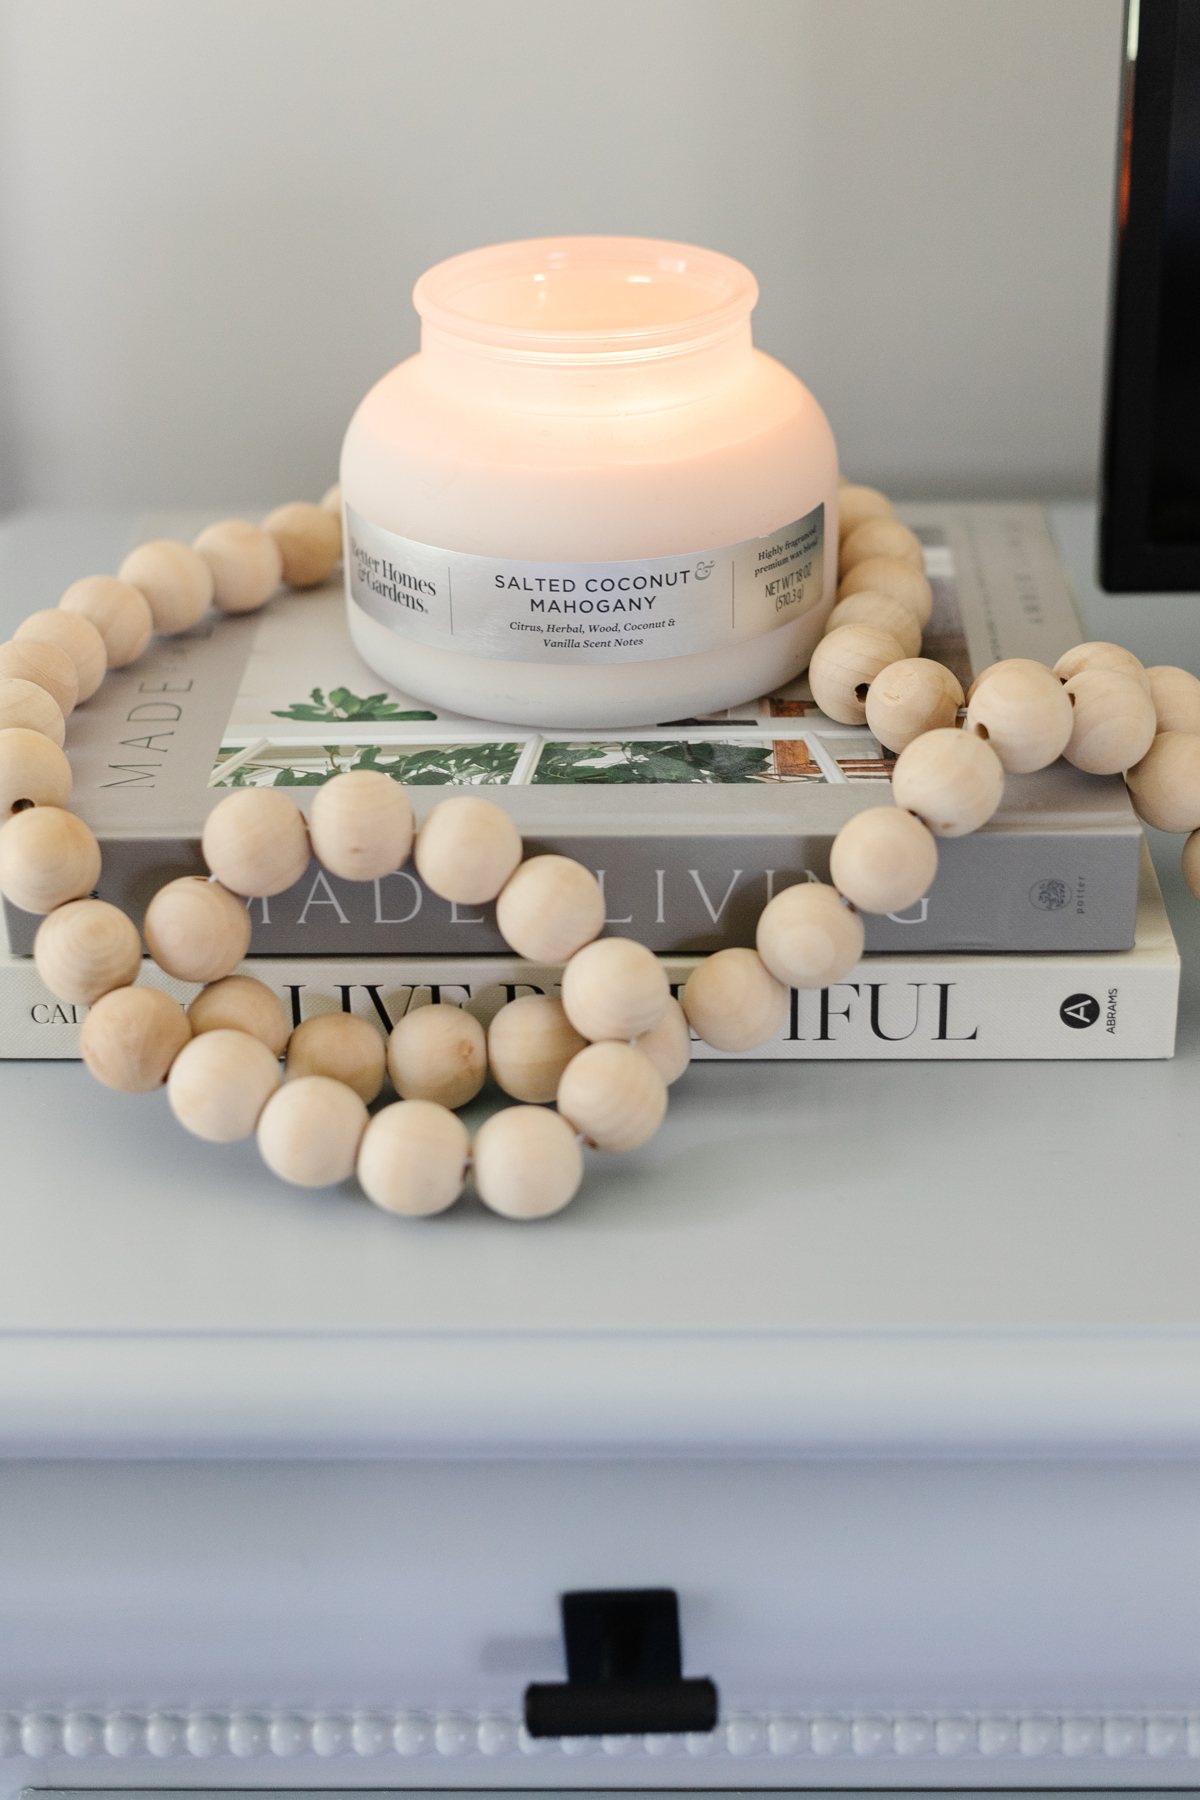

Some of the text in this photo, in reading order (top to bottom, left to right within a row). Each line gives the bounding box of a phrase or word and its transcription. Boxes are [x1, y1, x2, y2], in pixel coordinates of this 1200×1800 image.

[754, 556, 789, 578] premium
[789, 549, 803, 561] wax
[758, 545, 784, 561] Highly
[382, 559, 436, 597] Homes
[495, 560, 716, 593] SALTED COCONUT &
[765, 578, 781, 598] NET
[781, 571, 795, 591] WT
[530, 595, 657, 614] MAHOGANY
[509, 618, 676, 635] Citrus, Herbal, Wood, Coconut &
[543, 637, 644, 648] Vanilla Scent Notes
[99, 678, 194, 789] MADE
[1076, 876, 1086, 914] potter
[1106, 988, 1119, 1034] ABRAMS
